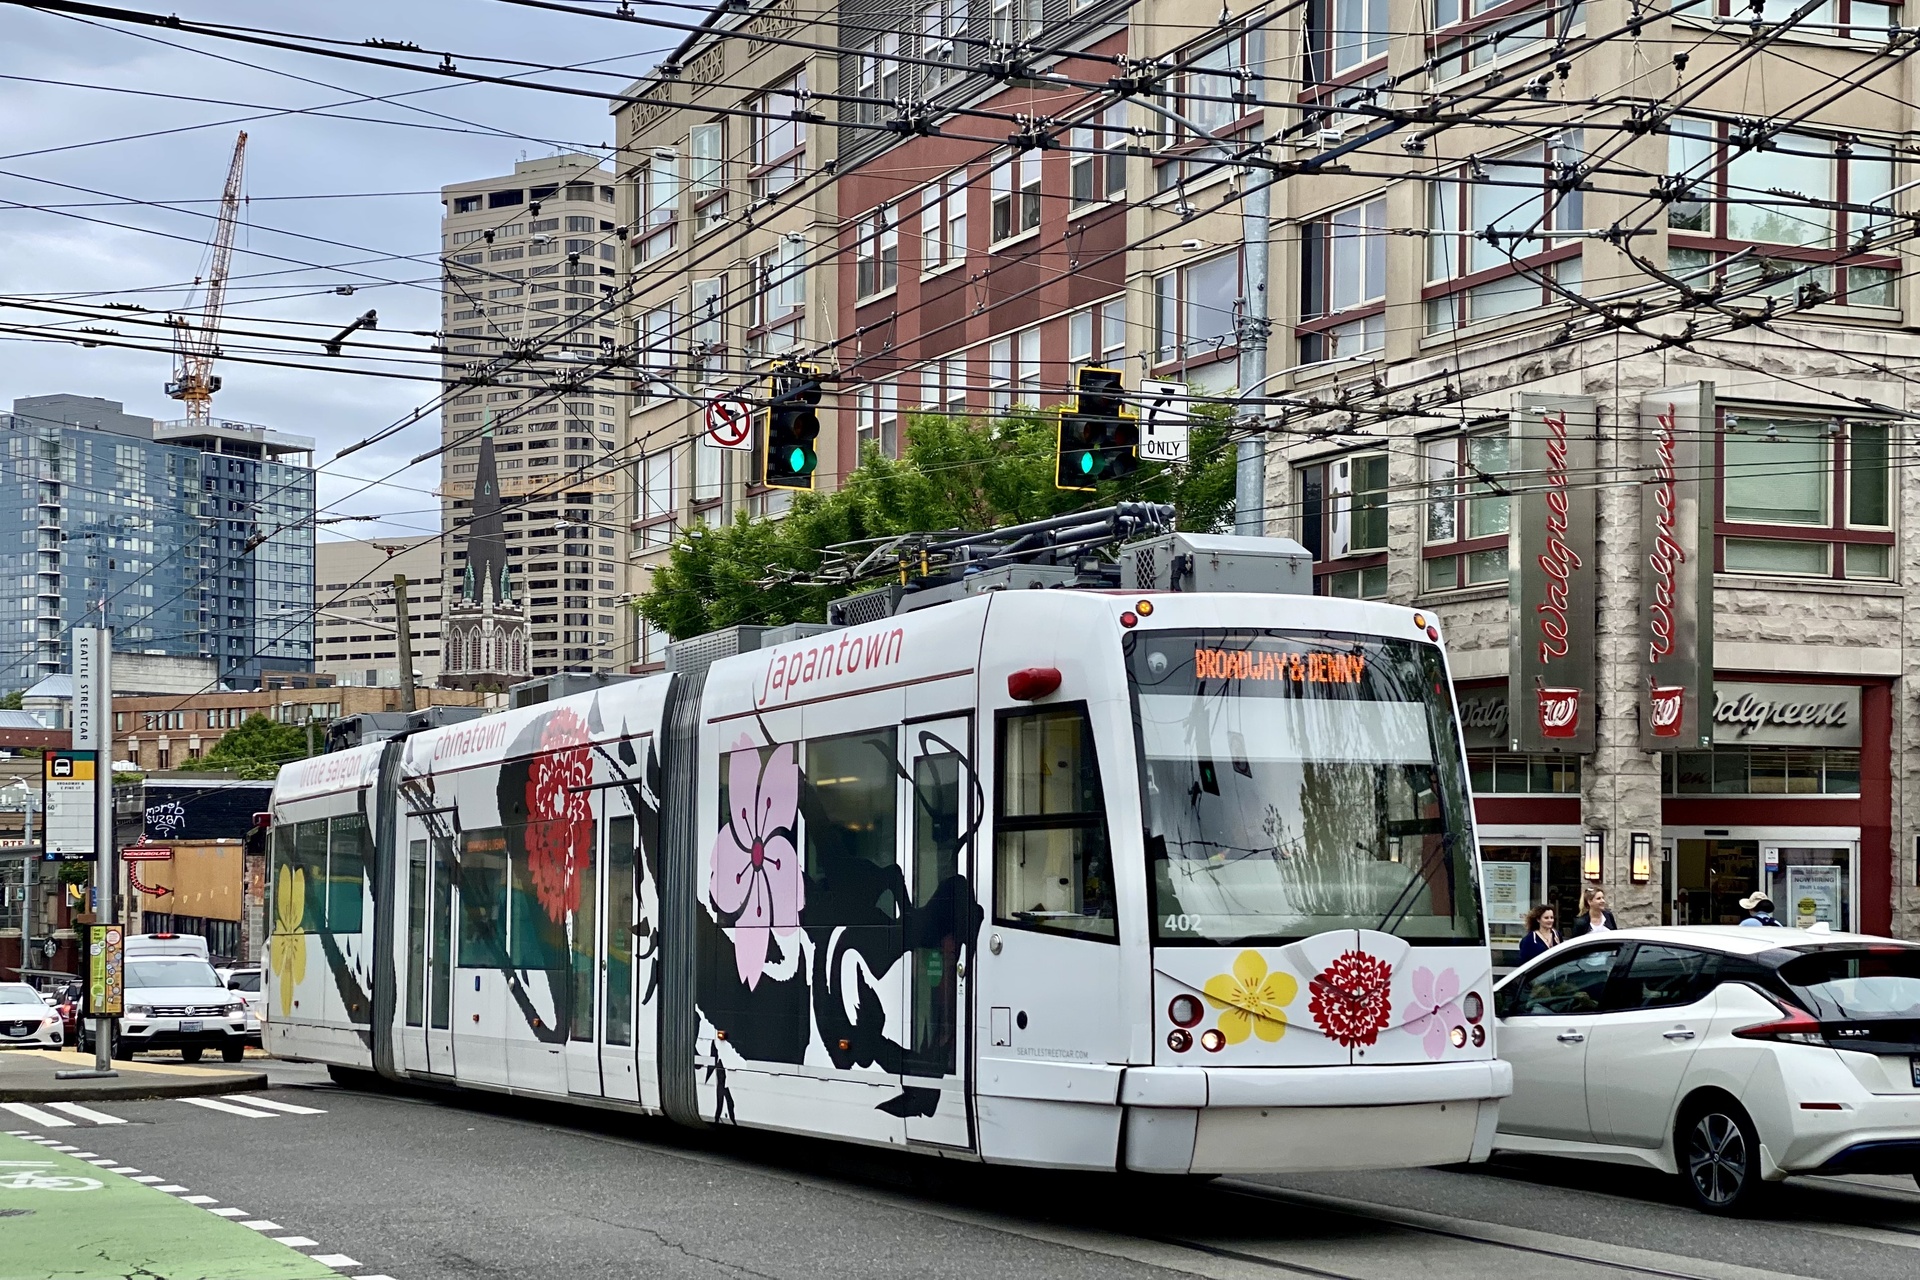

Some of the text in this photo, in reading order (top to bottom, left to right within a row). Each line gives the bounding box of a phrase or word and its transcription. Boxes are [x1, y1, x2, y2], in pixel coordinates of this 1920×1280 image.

[1147, 439, 1180, 456] ONLY
[1536, 408, 1583, 664] Walgreens
[1649, 402, 1686, 664] Walgreens
[758, 626, 904, 706] japantown
[1195, 649, 1287, 681] BROADWAY
[1308, 653, 1365, 684] DENNY
[80, 637, 89, 741] SEATTLE STREETCAR
[434, 721, 506, 760] chinatown
[299, 752, 362, 789] little saigon
[1164, 913, 1203, 932] 402
[1016, 1047, 1089, 1060] SEATTLESTREETCAR.COM
